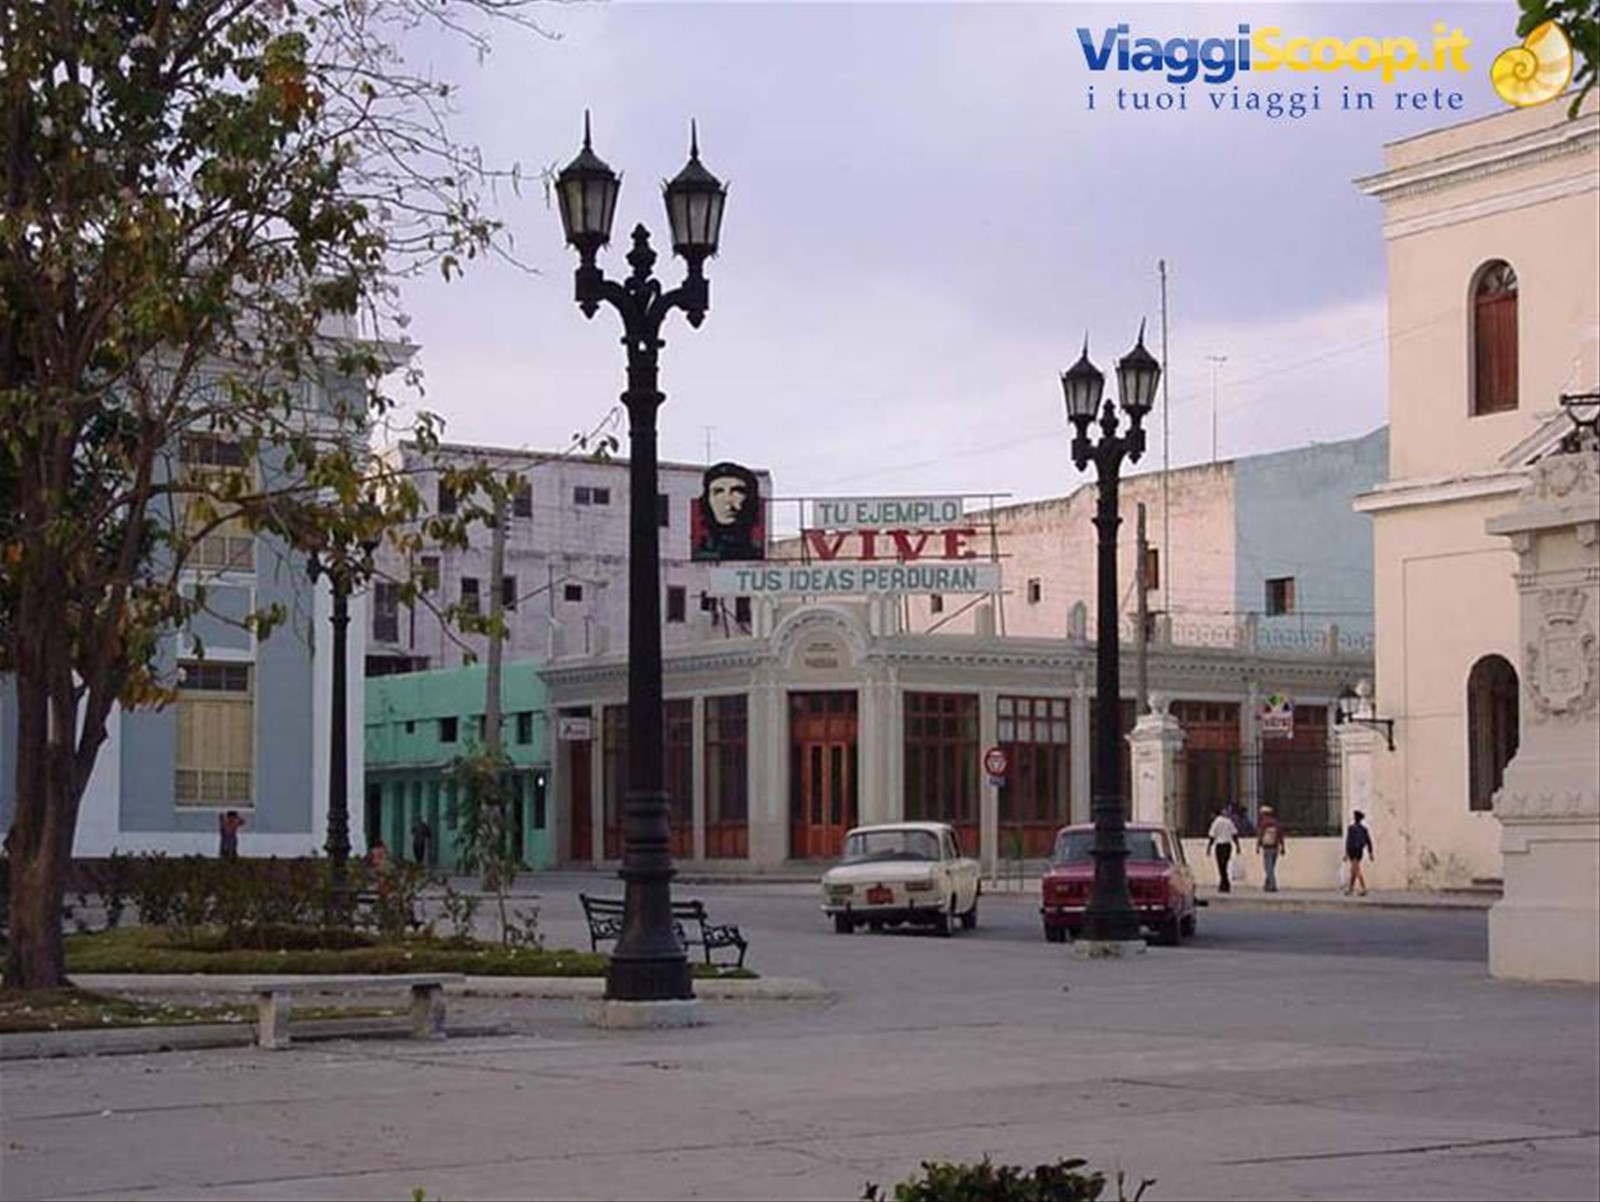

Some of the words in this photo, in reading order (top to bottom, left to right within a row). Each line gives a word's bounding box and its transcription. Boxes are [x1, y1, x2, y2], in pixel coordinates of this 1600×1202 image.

[818, 502, 849, 524] TU
[856, 501, 958, 524] EJEMPLO
[803, 528, 977, 561] VIVE
[736, 570, 782, 591] TUS
[789, 568, 855, 591] IDEAS
[861, 567, 977, 590] PERDURAN
